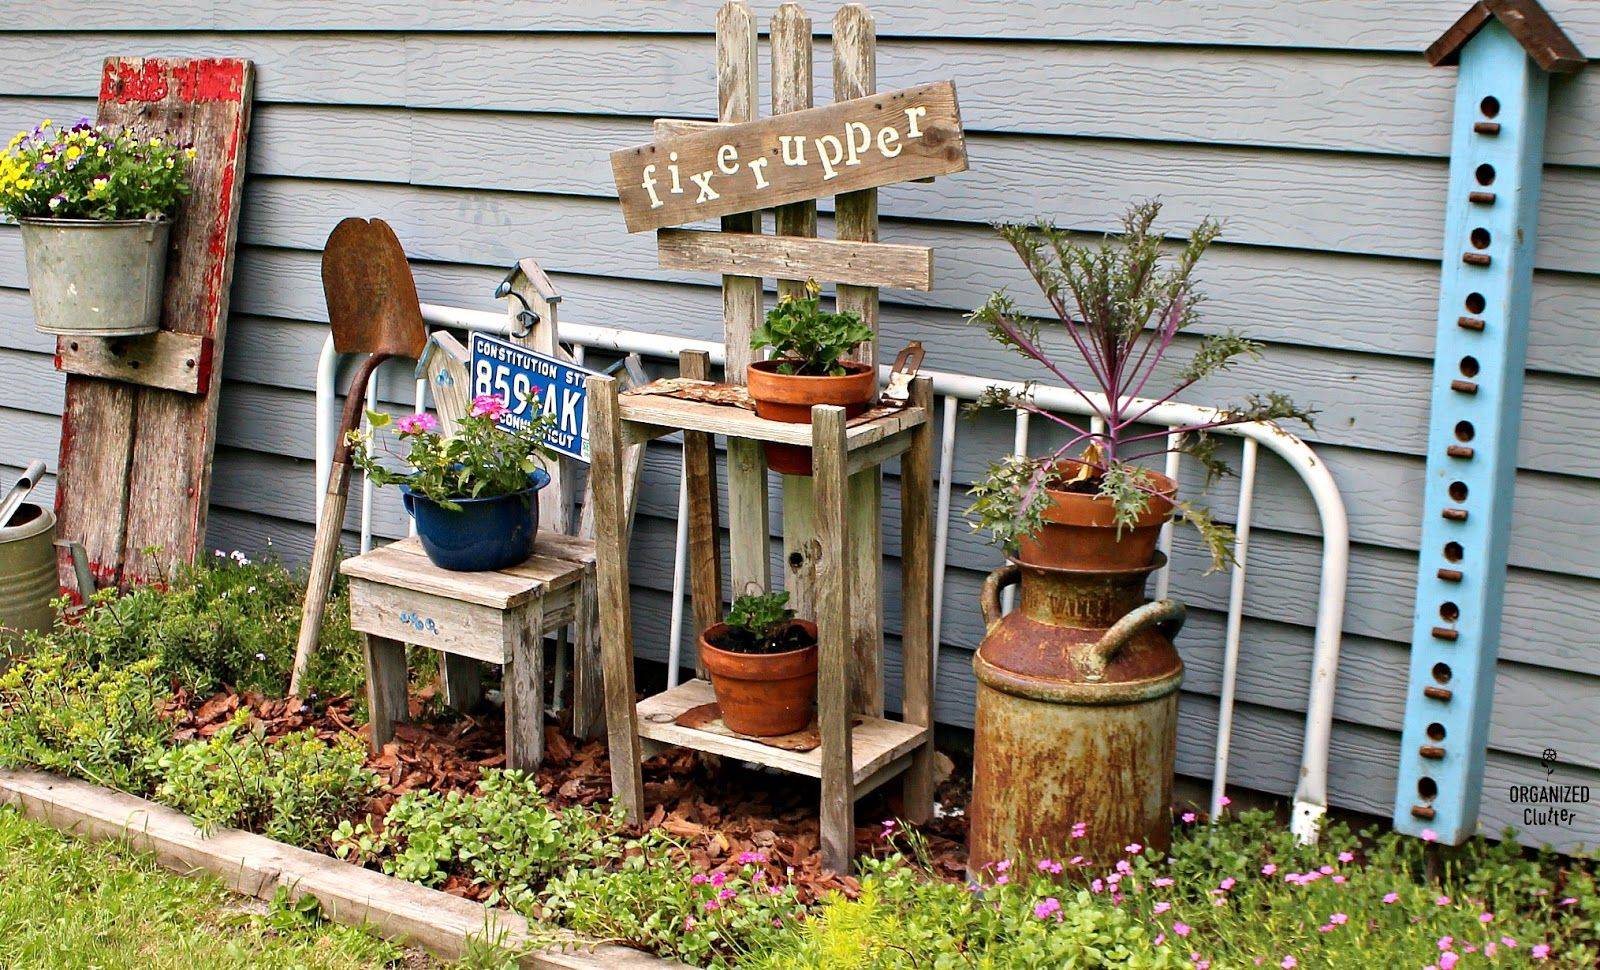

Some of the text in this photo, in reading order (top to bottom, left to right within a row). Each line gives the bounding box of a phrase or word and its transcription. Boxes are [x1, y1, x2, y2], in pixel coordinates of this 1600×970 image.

[641, 106, 927, 209] fixer upper
[477, 341, 558, 379] CONSTITUTION
